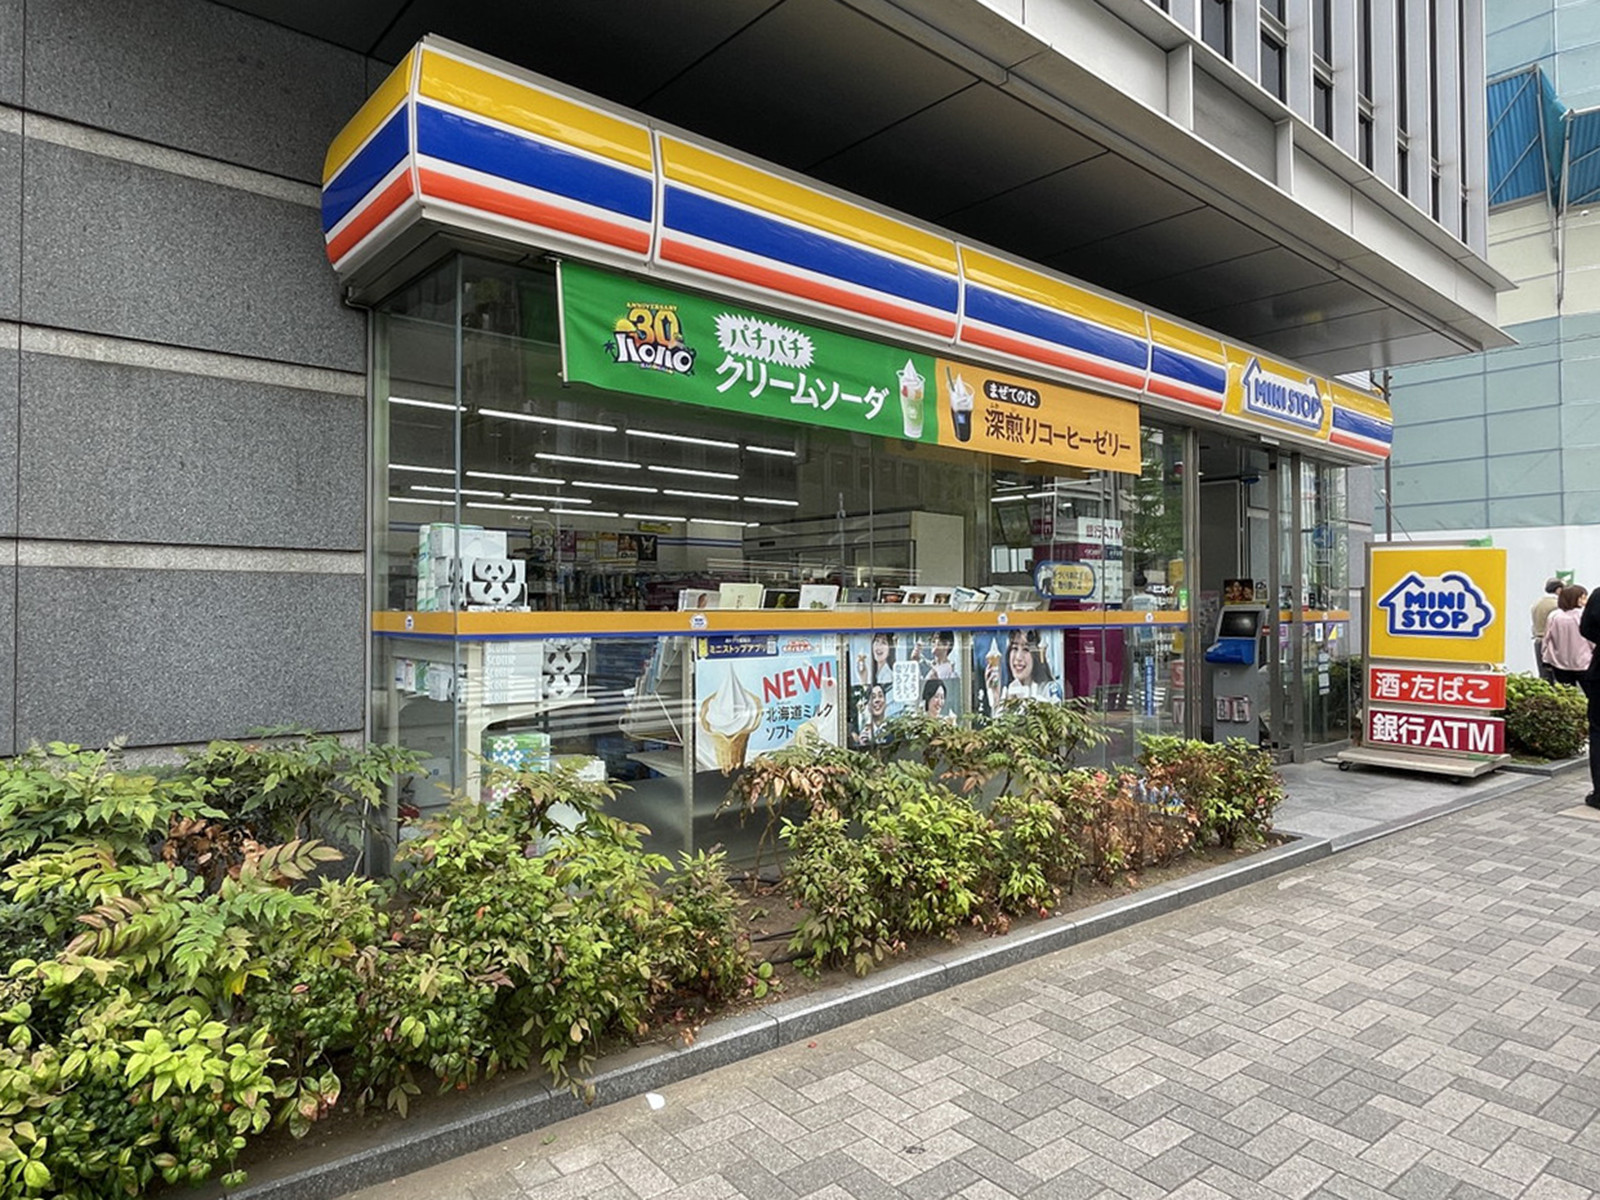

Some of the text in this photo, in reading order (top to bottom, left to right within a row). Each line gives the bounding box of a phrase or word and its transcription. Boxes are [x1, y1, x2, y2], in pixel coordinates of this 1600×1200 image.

[629, 308, 680, 348] 30
[730, 324, 804, 359] パチパチ
[716, 355, 888, 419] クリームソーダ
[989, 383, 1036, 406] まぜてのむ
[1254, 378, 1321, 420] MINI STOP
[985, 408, 1131, 456] 深煎りコーヒーゼリー
[1404, 591, 1466, 610] MINI
[1401, 610, 1469, 629] STOP
[762, 661, 834, 704] NEW!
[1375, 671, 1491, 704] 酒・たばこ
[766, 703, 834, 723] 北海道ミルク
[765, 724, 794, 742] ソフト
[1372, 713, 1495, 752] 銀行ATM
